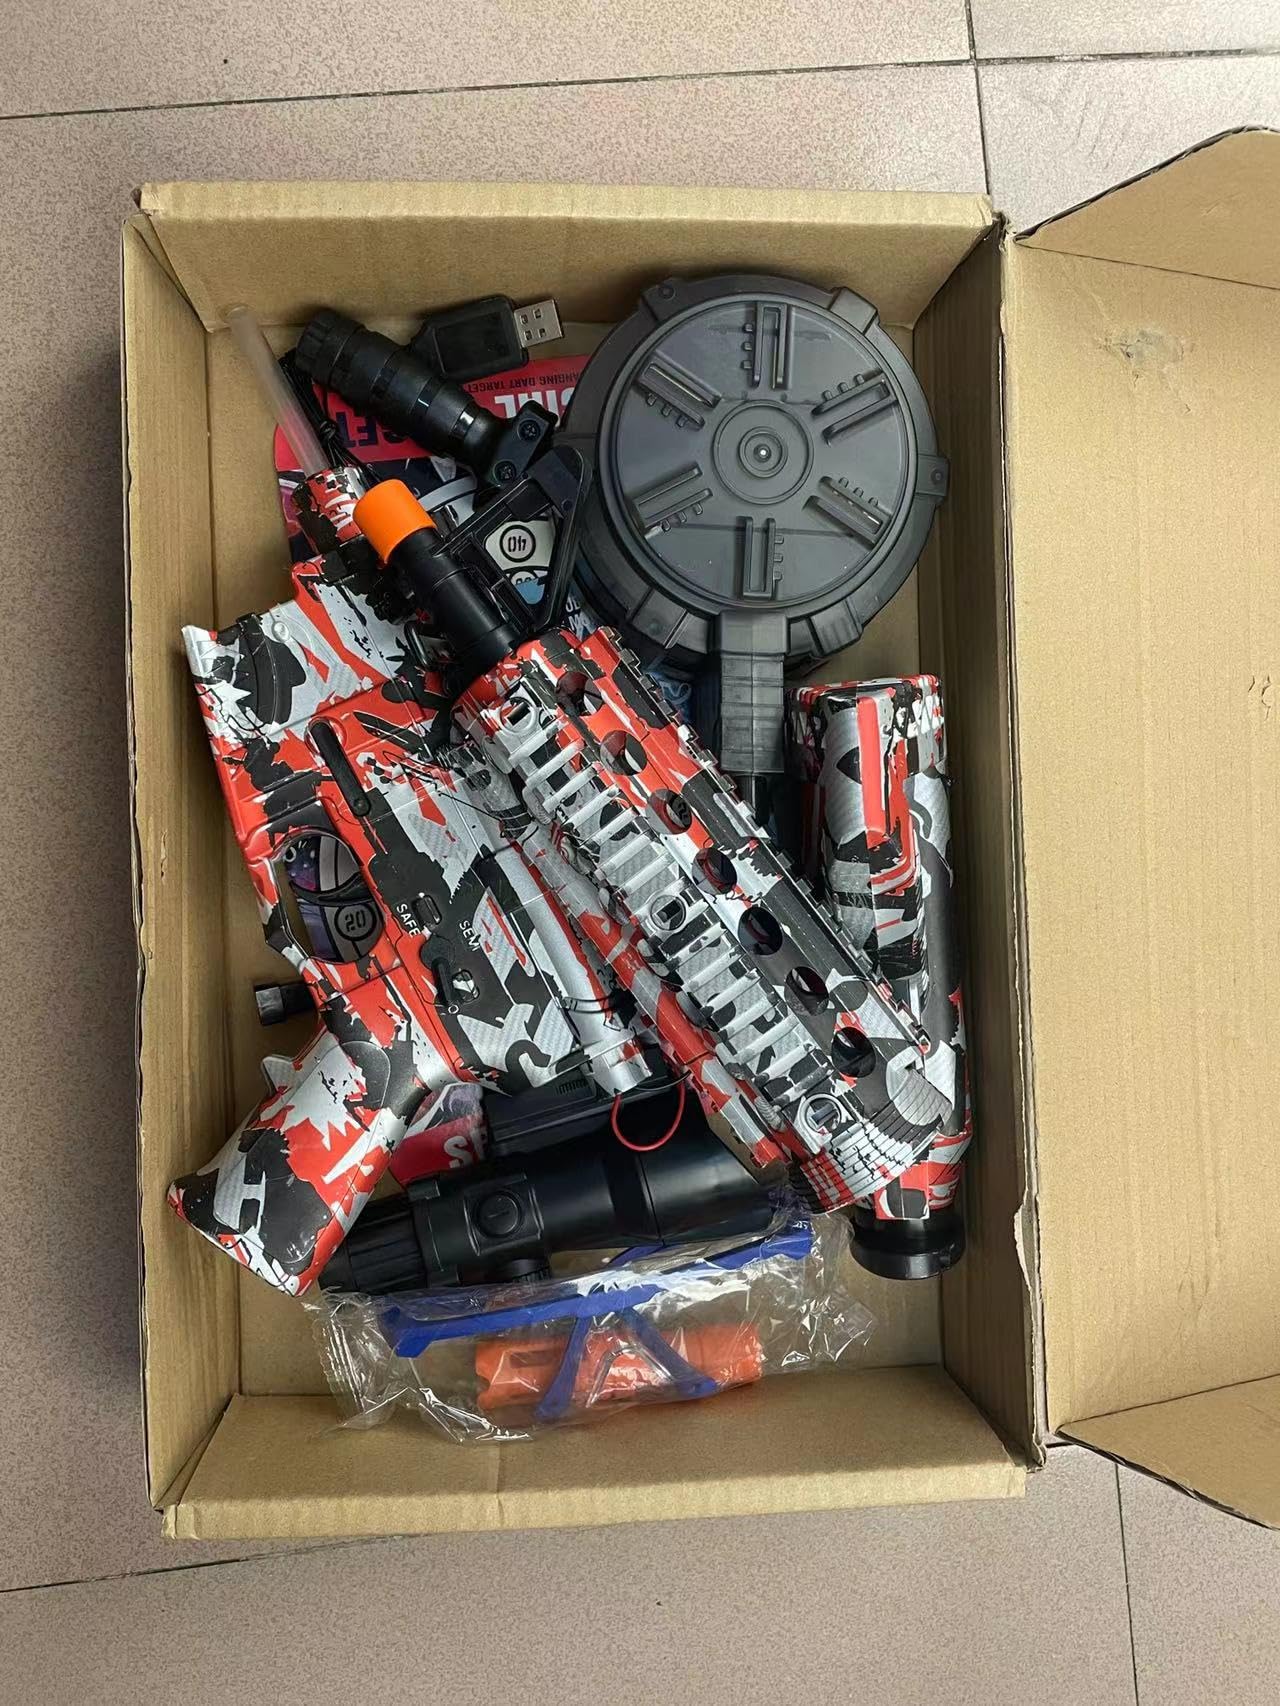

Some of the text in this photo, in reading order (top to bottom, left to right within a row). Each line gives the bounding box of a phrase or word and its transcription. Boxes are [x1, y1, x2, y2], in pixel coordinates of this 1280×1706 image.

[509, 377, 536, 389] DART
[507, 535, 527, 553] 40
[344, 909, 366, 932] 20
[396, 903, 421, 938] SAFE
[459, 920, 481, 952] SEMI
